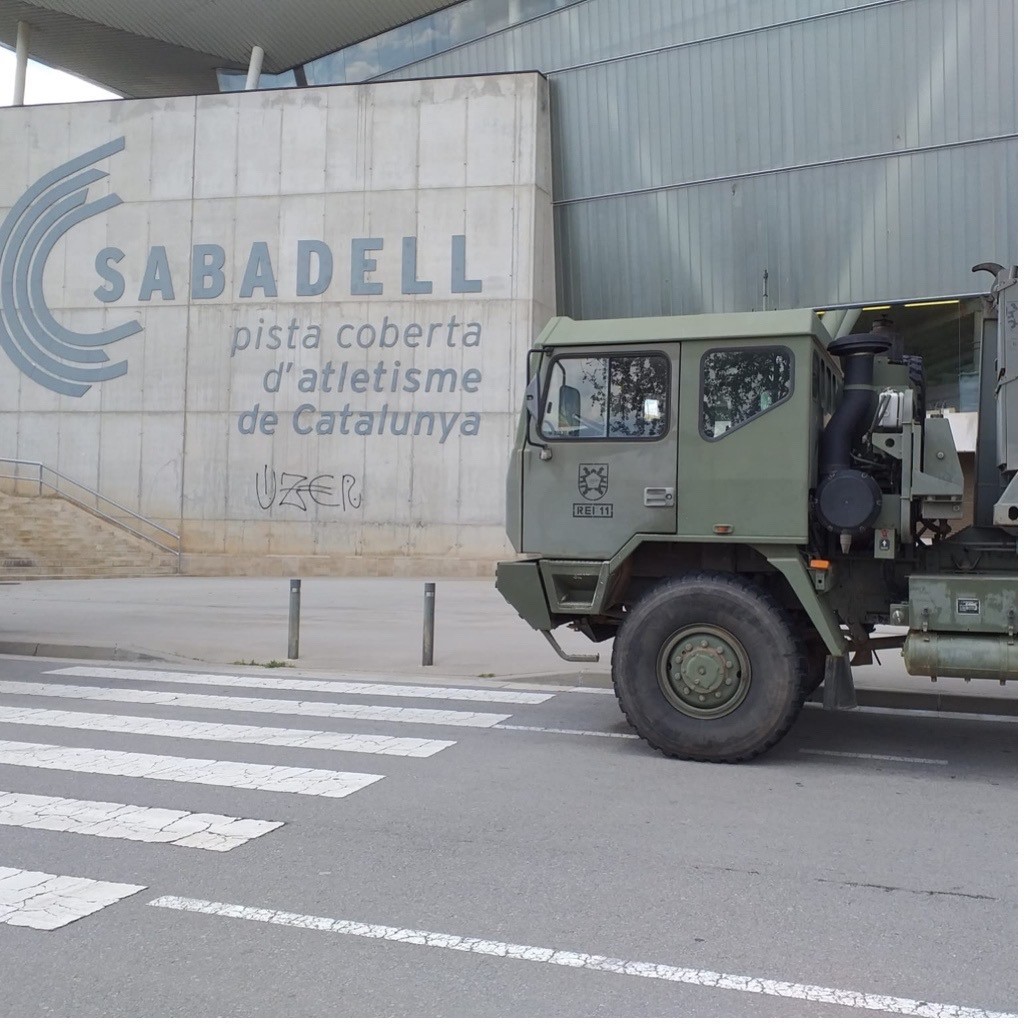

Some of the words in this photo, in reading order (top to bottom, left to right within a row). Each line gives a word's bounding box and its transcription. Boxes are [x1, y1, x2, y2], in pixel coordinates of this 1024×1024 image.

[93, 235, 482, 302] SABADELL
[230, 318, 321, 357] pista
[336, 315, 482, 348] coberta
[263, 360, 482, 393] d'atletisme
[238, 403, 279, 436] de
[292, 402, 482, 444] Catalunya
[577, 506, 595, 515] REI
[600, 506, 609, 515] 11
